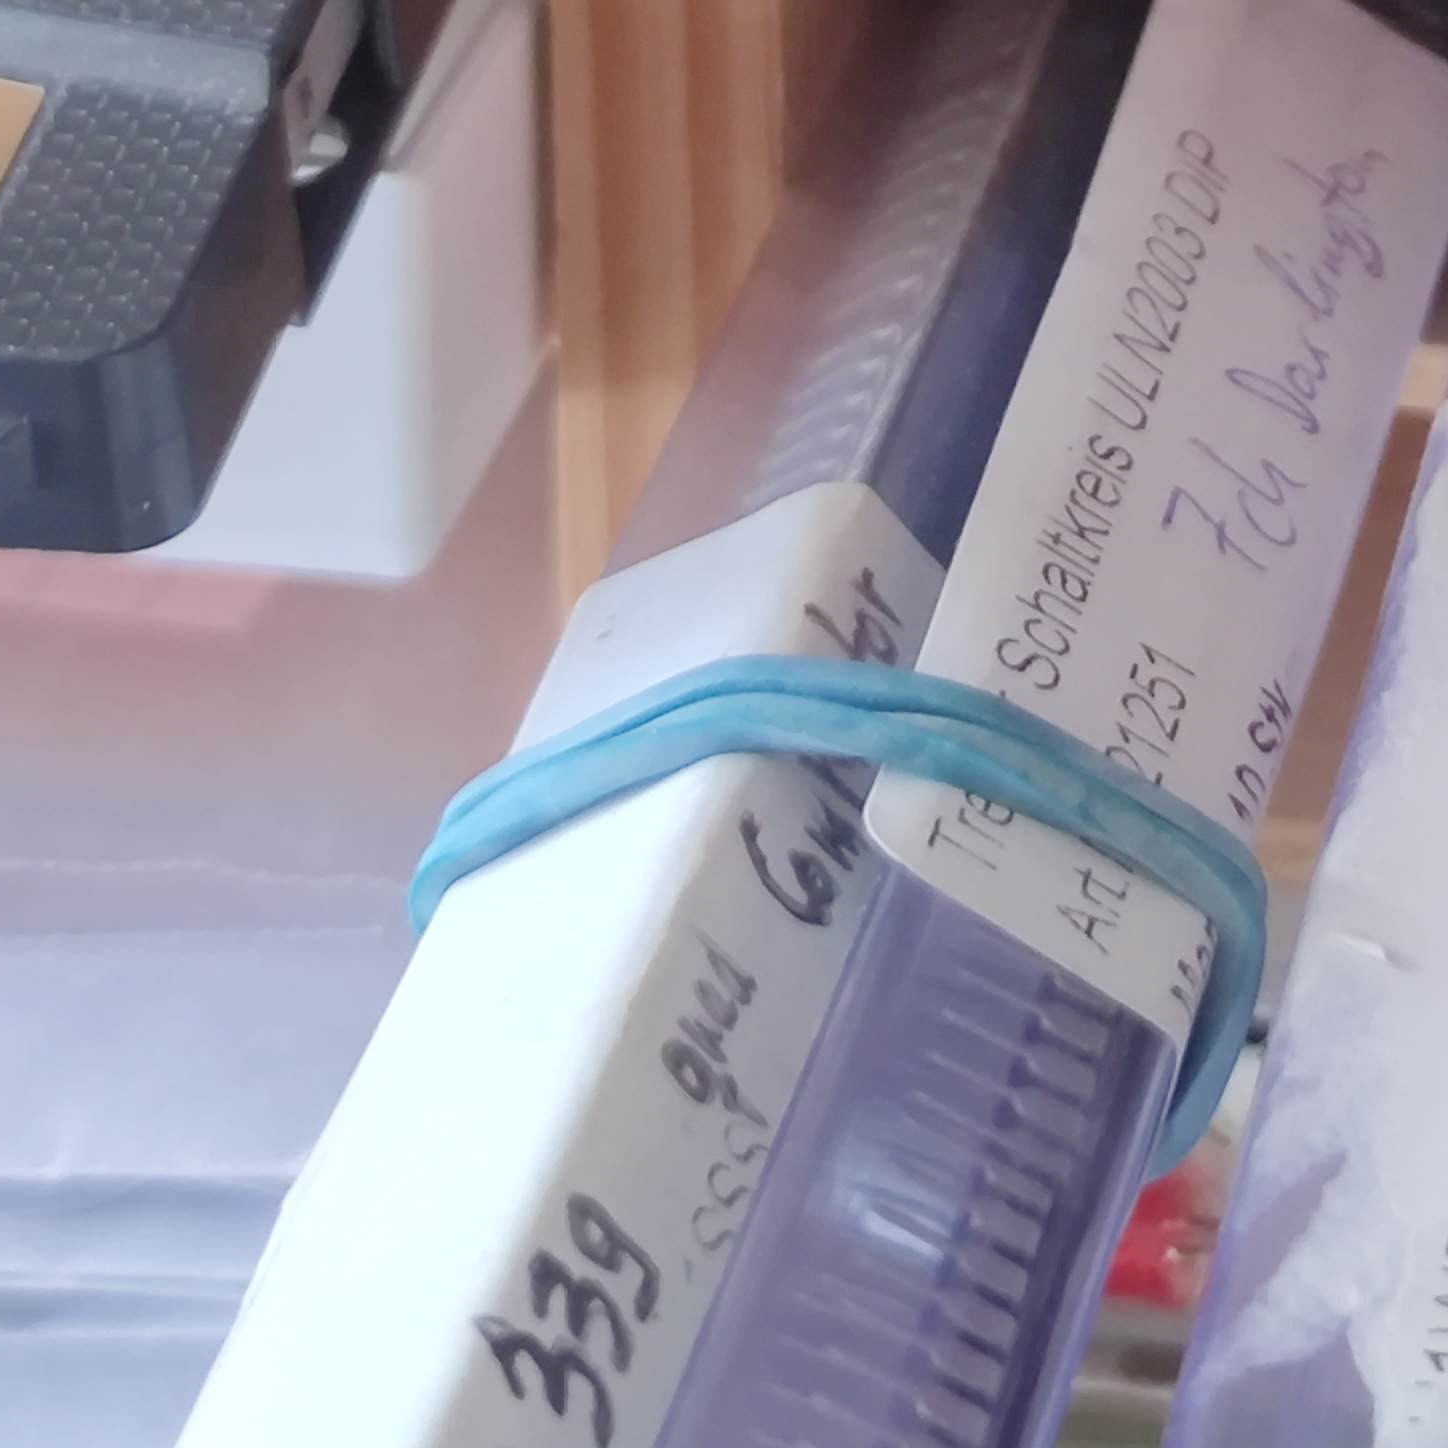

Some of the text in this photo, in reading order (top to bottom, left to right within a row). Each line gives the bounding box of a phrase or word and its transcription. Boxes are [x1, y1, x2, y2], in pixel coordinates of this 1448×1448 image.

[996, 129, 1237, 693] Schaltkreis ULN2003 DIP
[473, 1191, 659, 1448] 339
